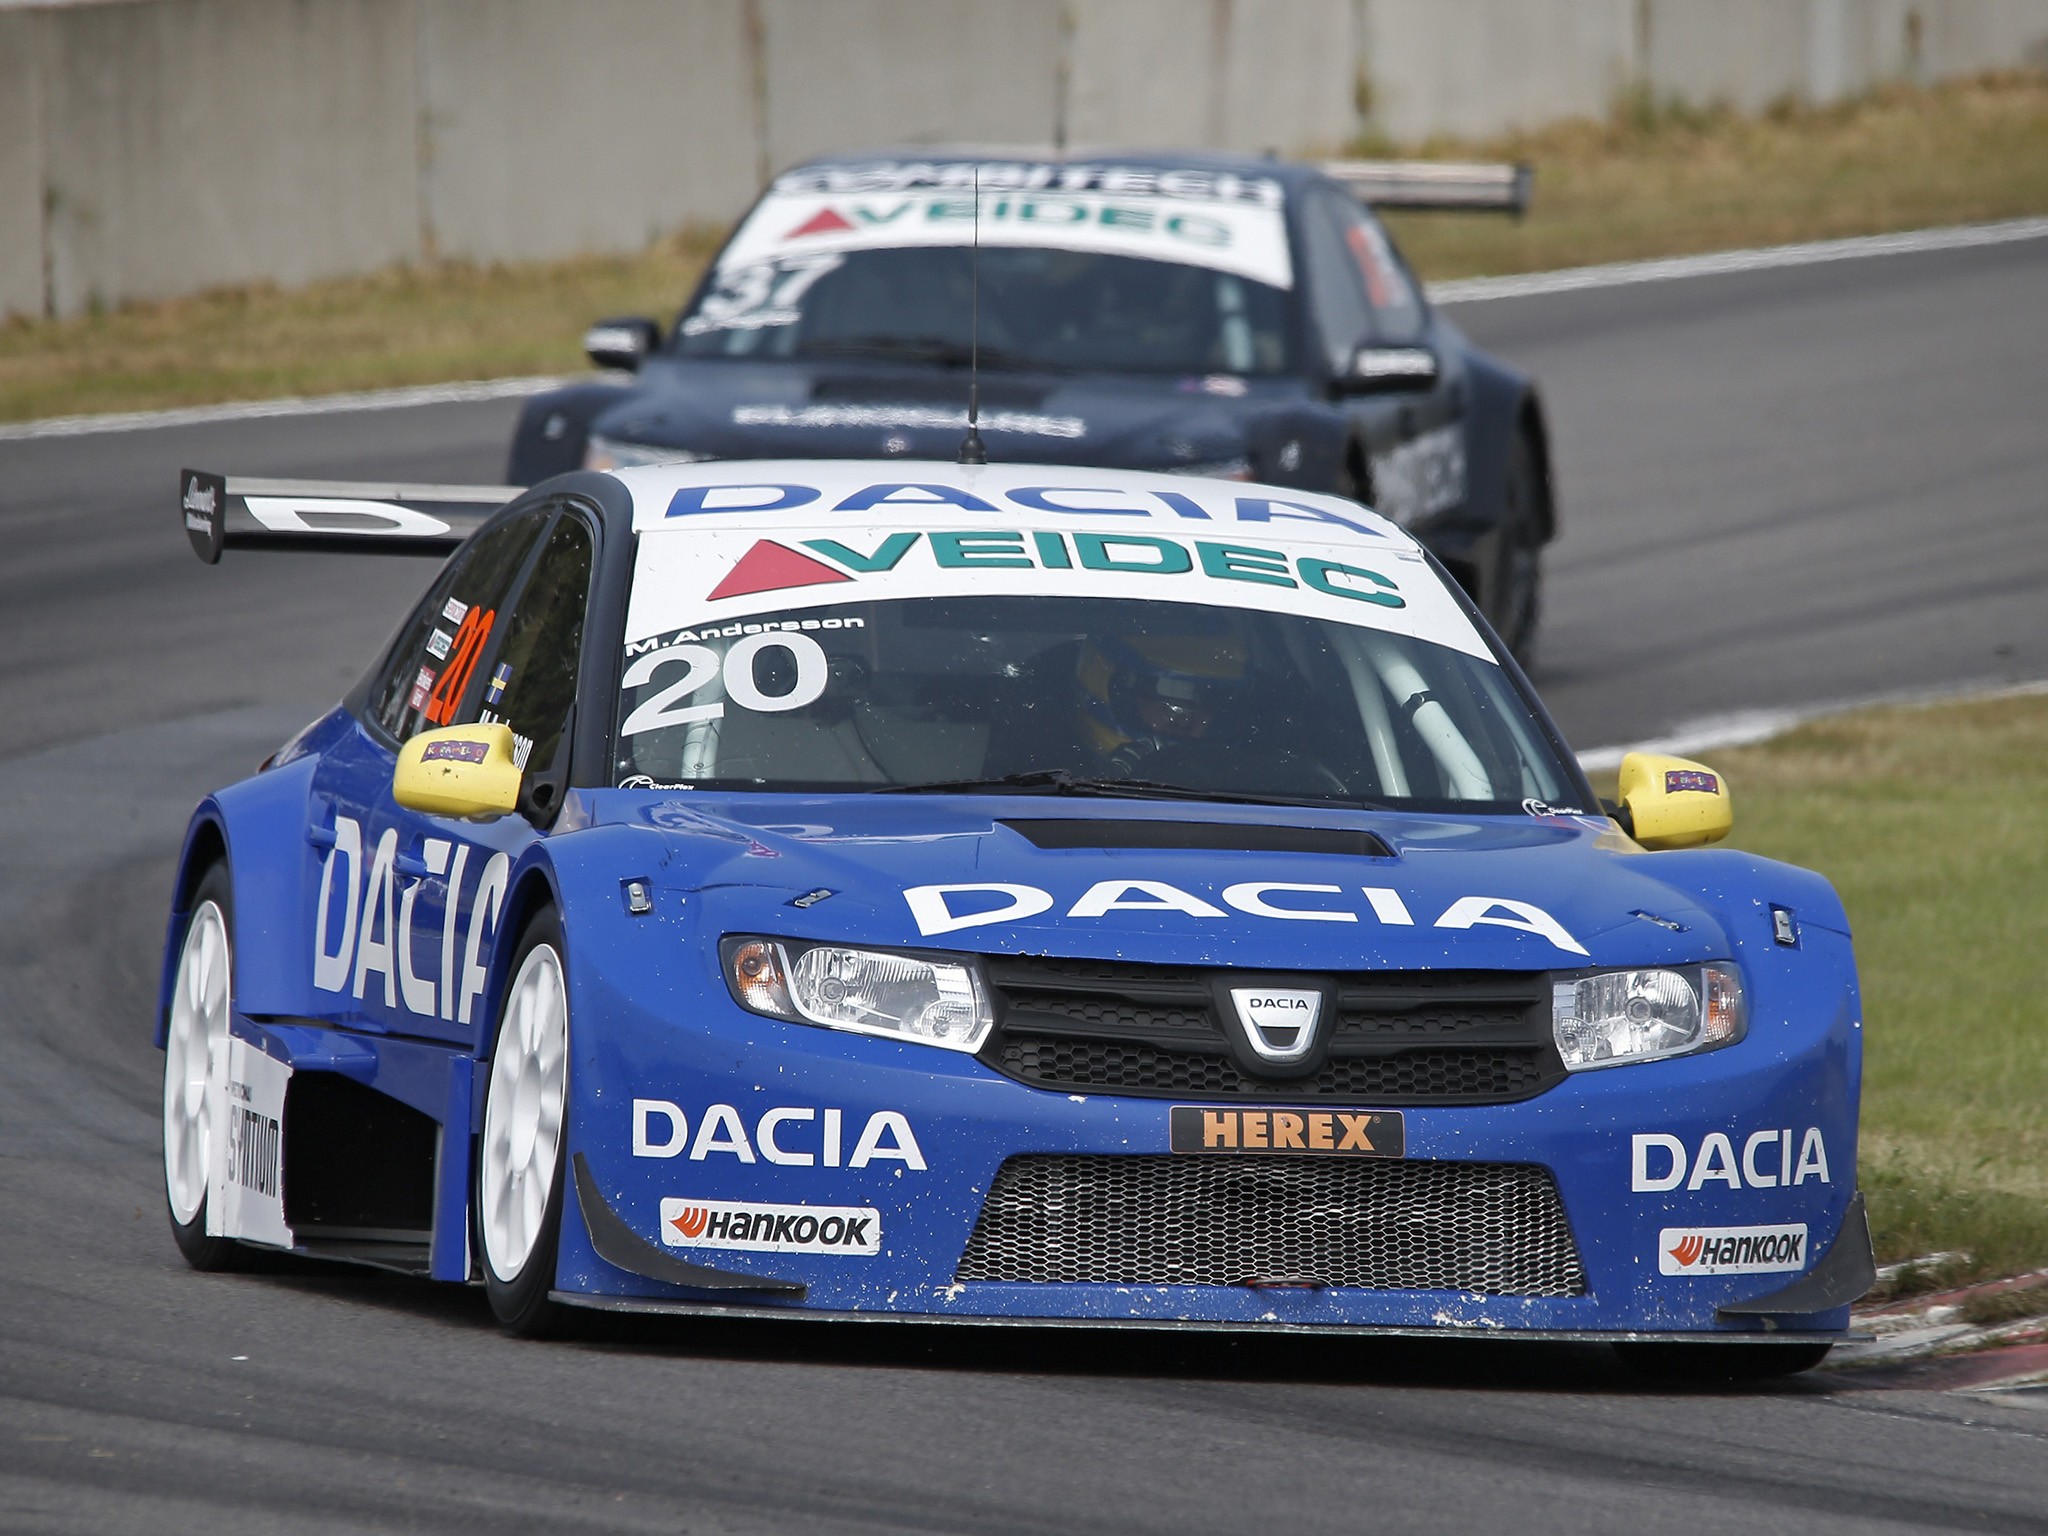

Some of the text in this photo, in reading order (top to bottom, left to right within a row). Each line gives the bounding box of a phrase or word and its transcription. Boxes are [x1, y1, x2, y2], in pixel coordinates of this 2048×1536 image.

[664, 482, 1389, 538] DACIA
[800, 530, 1406, 609] VEIDEC
[424, 605, 496, 727] 20
[624, 617, 865, 657] M.Andersson
[621, 631, 828, 738] 20
[314, 815, 508, 1025] DACIA
[902, 879, 1591, 957] DACIA
[1250, 998, 1309, 1011] DACIA
[632, 1098, 928, 1171] DACIA
[1203, 1111, 1376, 1152] HEREX
[1631, 1127, 1831, 1192] DACIA
